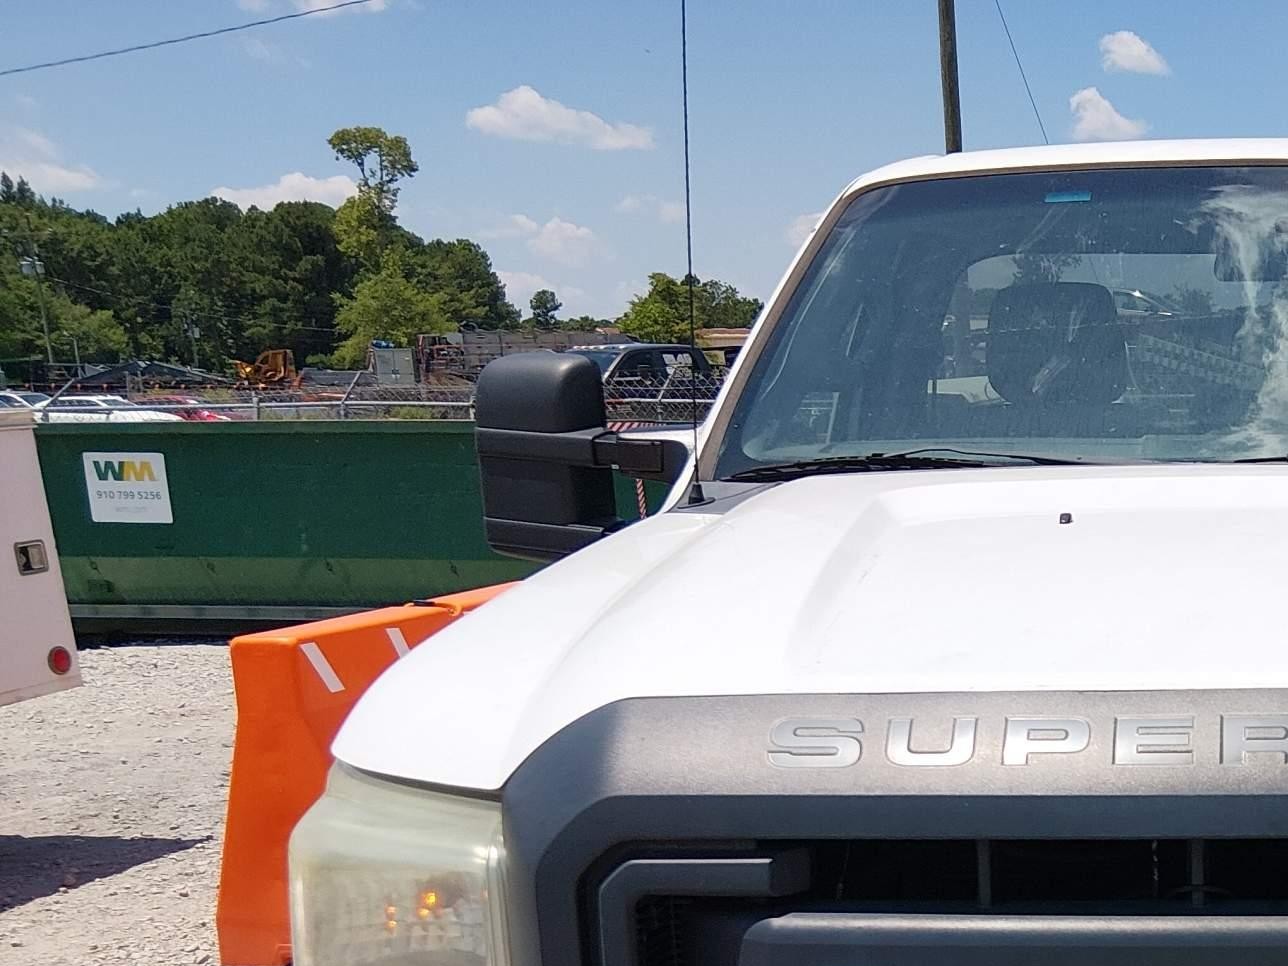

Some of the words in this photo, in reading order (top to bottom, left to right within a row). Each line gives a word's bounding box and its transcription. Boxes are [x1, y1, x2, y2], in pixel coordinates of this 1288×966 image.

[92, 460, 158, 482] WM
[96, 490, 115, 500] 910
[116, 490, 136, 500] 799
